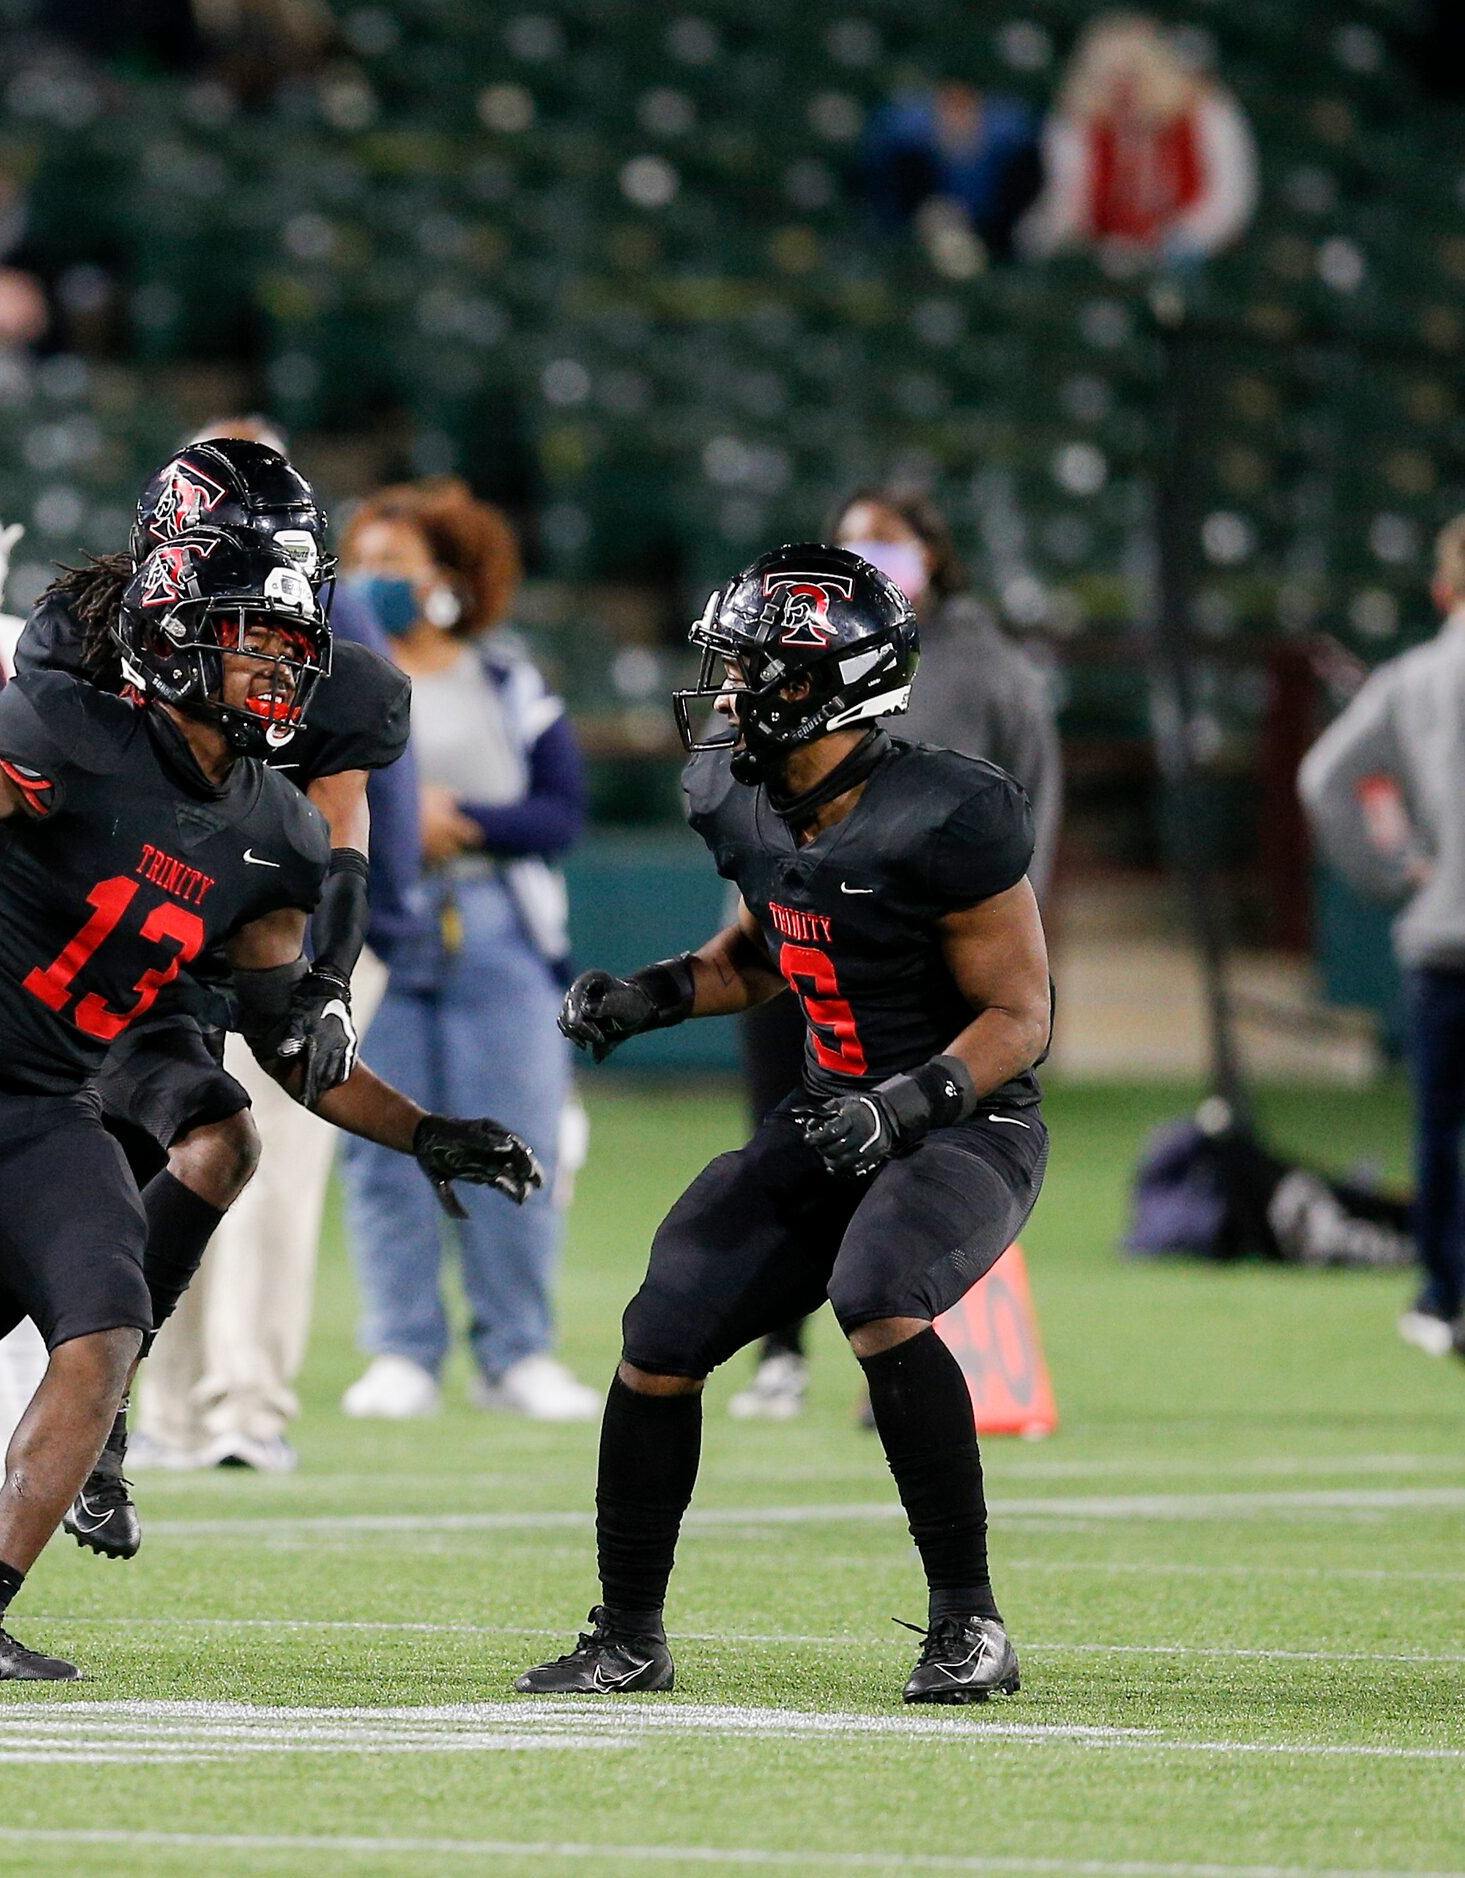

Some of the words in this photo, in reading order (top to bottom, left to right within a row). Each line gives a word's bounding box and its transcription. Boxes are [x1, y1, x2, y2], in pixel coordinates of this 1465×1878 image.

[136, 844, 216, 905] TRINITY
[768, 901, 833, 943] TRINITY
[22, 875, 205, 1040] 13
[780, 942, 869, 1076] 9
